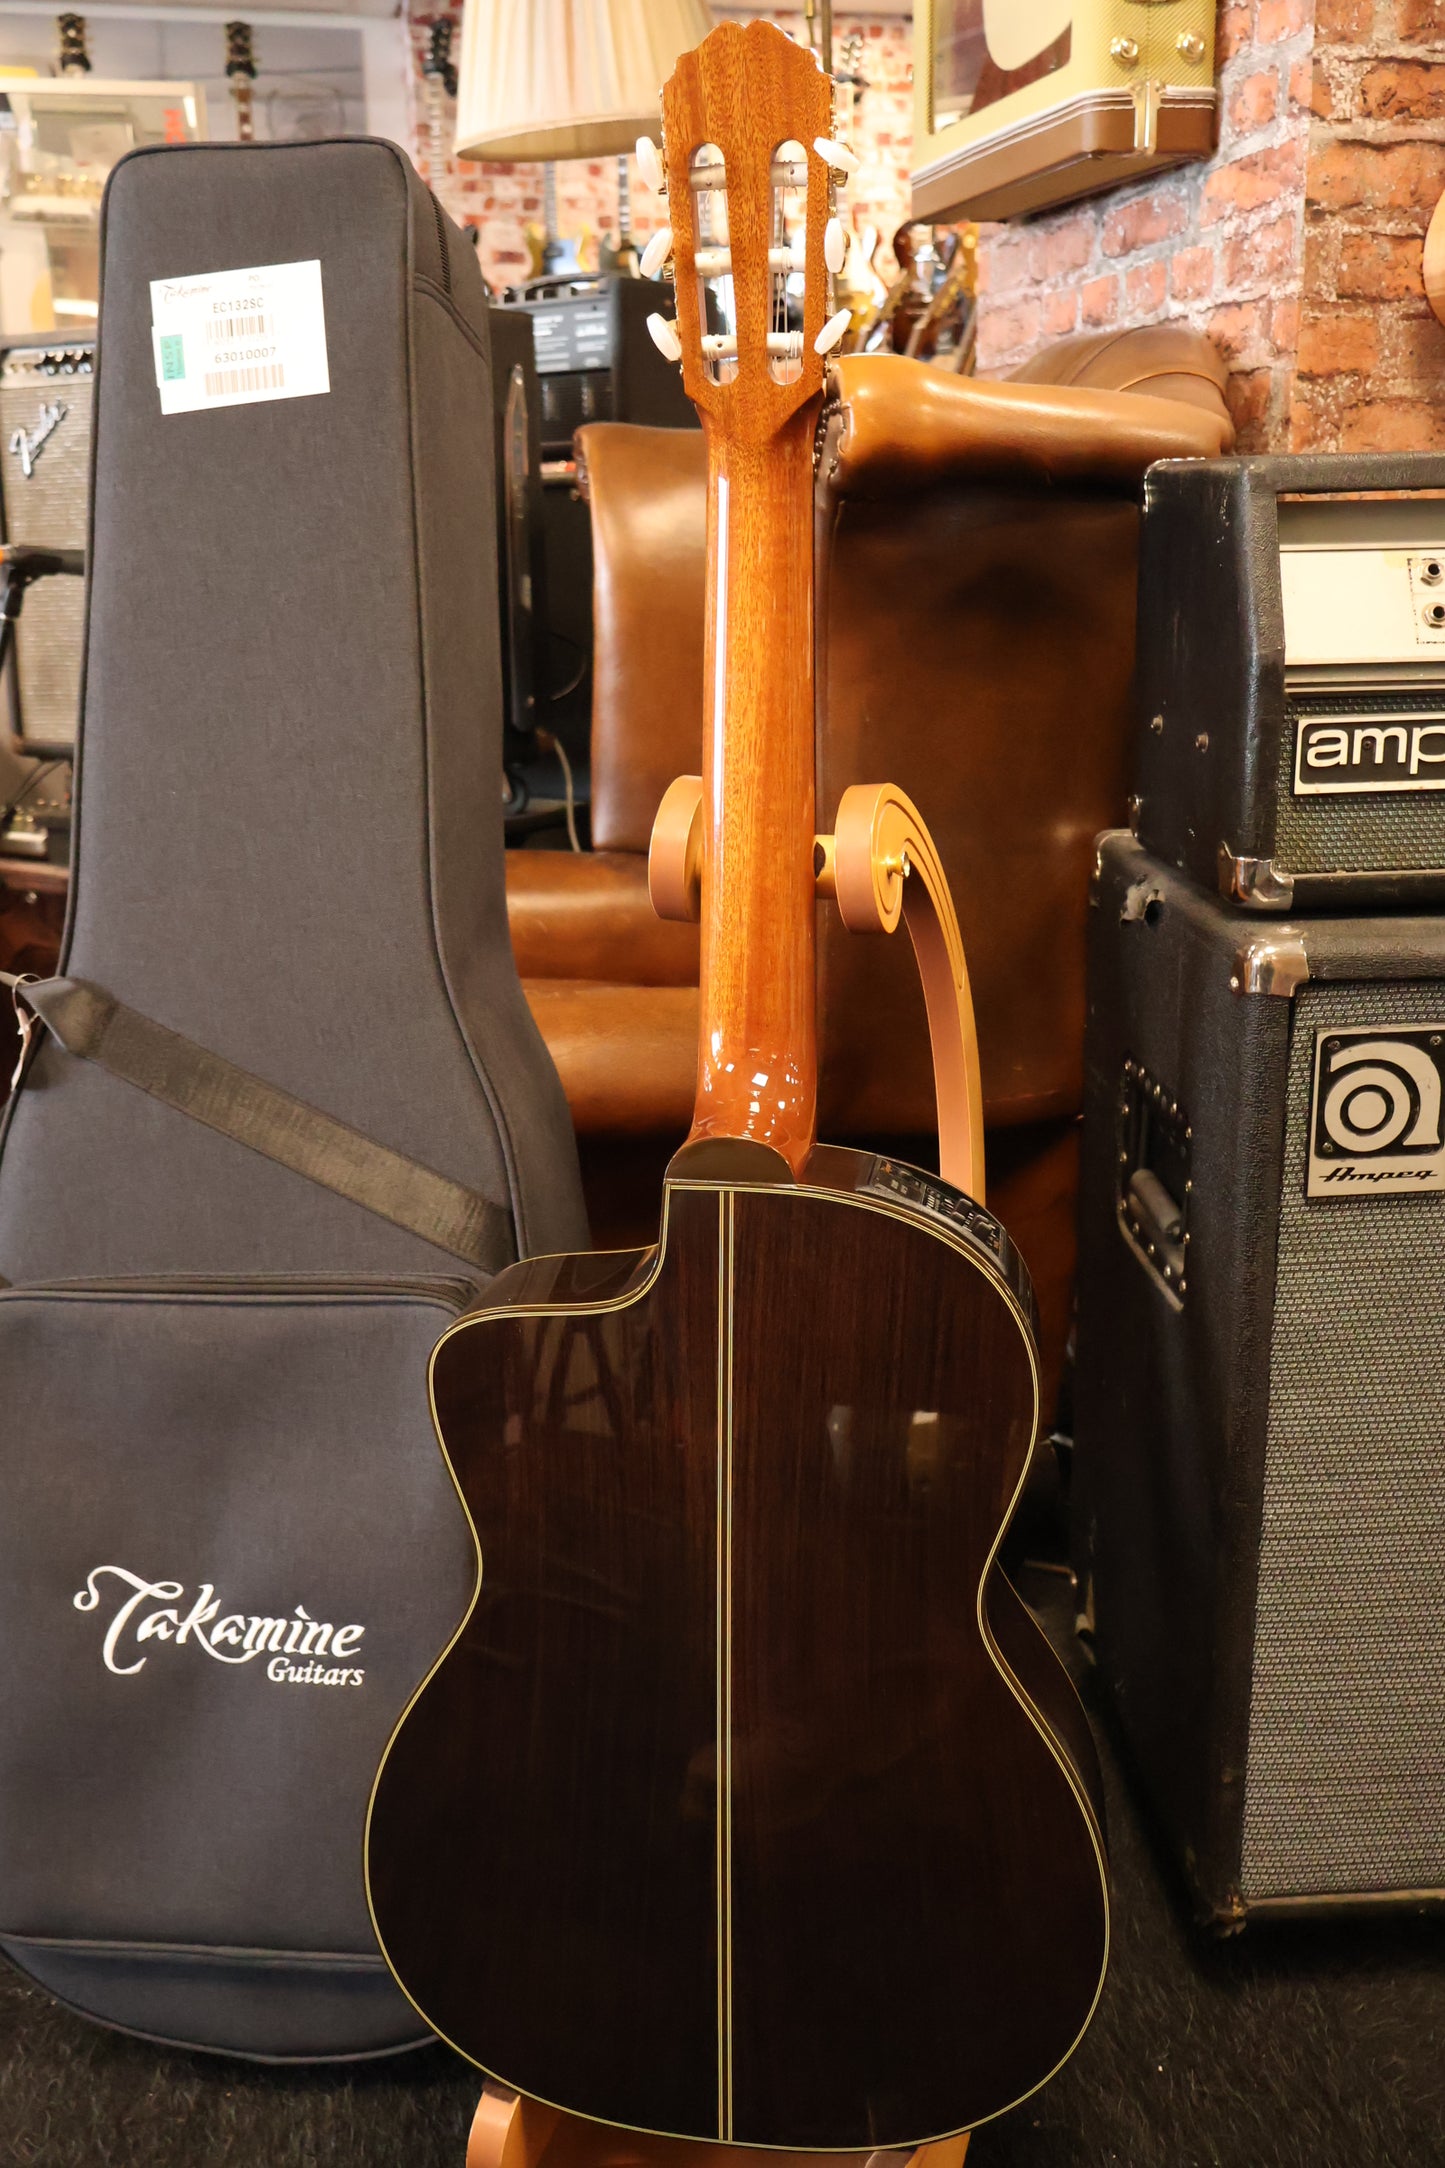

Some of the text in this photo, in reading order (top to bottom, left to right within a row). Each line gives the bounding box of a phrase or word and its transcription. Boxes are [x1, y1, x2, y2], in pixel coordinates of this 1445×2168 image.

[213, 297, 264, 314] EC132SC
[214, 347, 277, 364] 63010007
[1318, 1166, 1438, 1183] Ampeg
[73, 1565, 365, 1675] Takamine
[267, 1656, 365, 1686] Guitars
